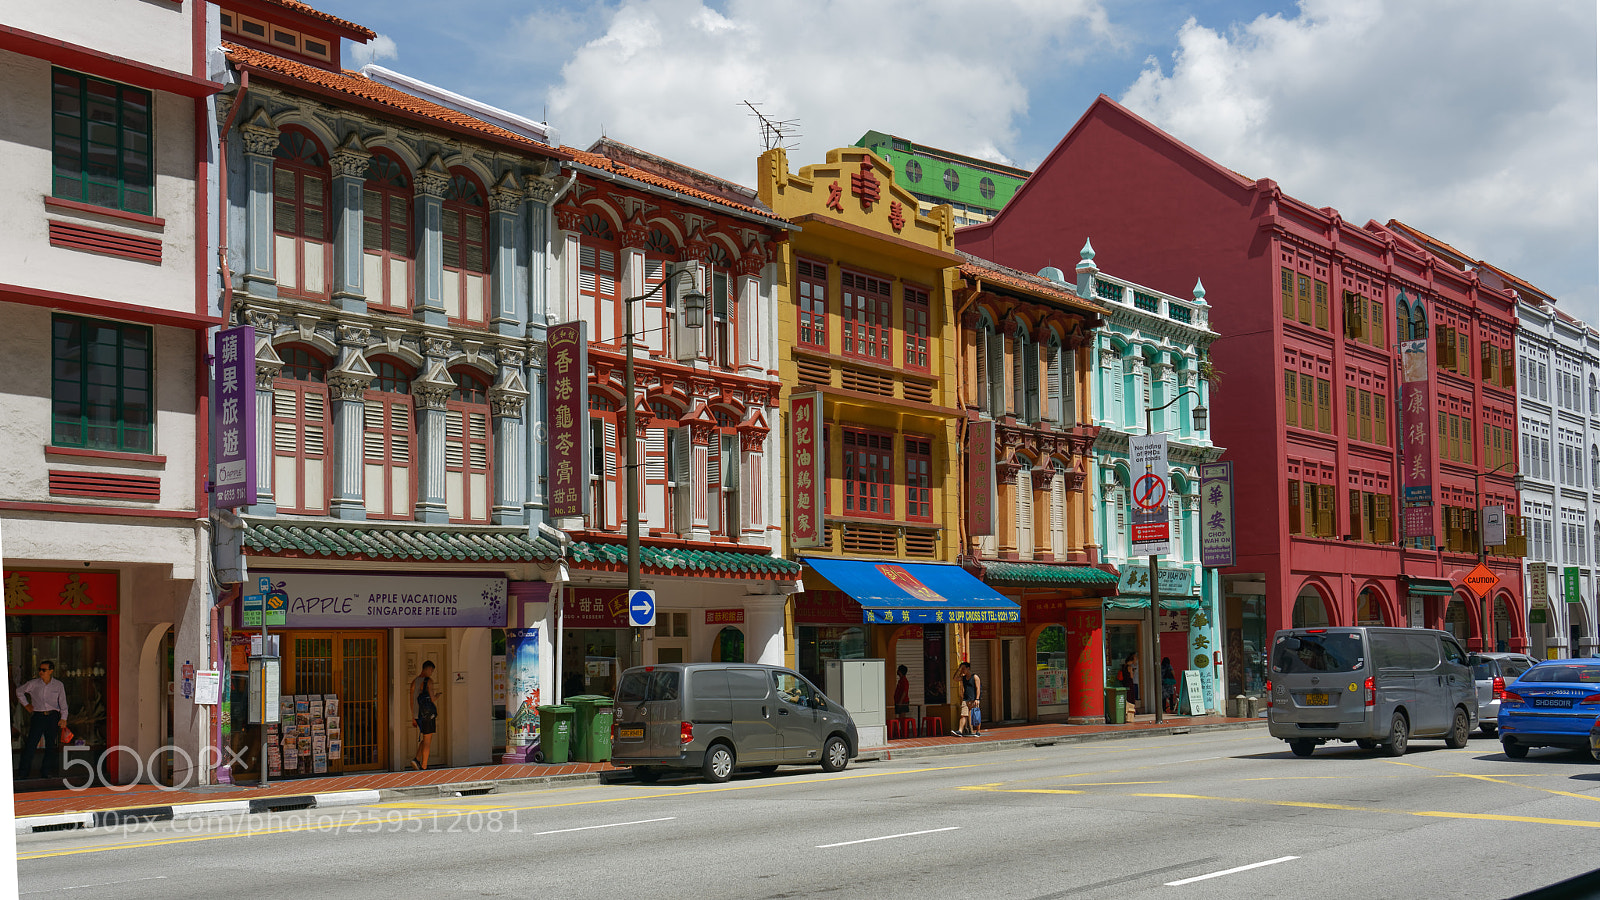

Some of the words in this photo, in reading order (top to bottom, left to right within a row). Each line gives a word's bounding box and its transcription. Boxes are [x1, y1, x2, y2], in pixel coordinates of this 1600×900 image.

[222, 334, 239, 457] 蘋果旅遊
[554, 348, 574, 485] 香港龜苓膏
[1408, 388, 1427, 480] 康得美
[553, 487, 578, 504] 甜品
[567, 505, 576, 513] 28
[1207, 484, 1226, 529] 華安
[1127, 570, 1148, 588] 華安
[291, 597, 352, 613] APPLE
[368, 594, 398, 603] APPLE
[401, 594, 457, 604] VACATIONS
[579, 597, 604, 612] 甜品
[367, 606, 422, 615] SINGAPORE
[425, 607, 440, 615] PTE
[443, 607, 457, 615] LTD
[948, 611, 955, 621] 32
[955, 611, 964, 621] UPP
[965, 611, 981, 621] CROSS
[981, 611, 987, 621] ST
[988, 611, 997, 621] TEL:
[1192, 612, 1210, 650] 華安
[1535, 699, 1571, 707] SHD6501R
